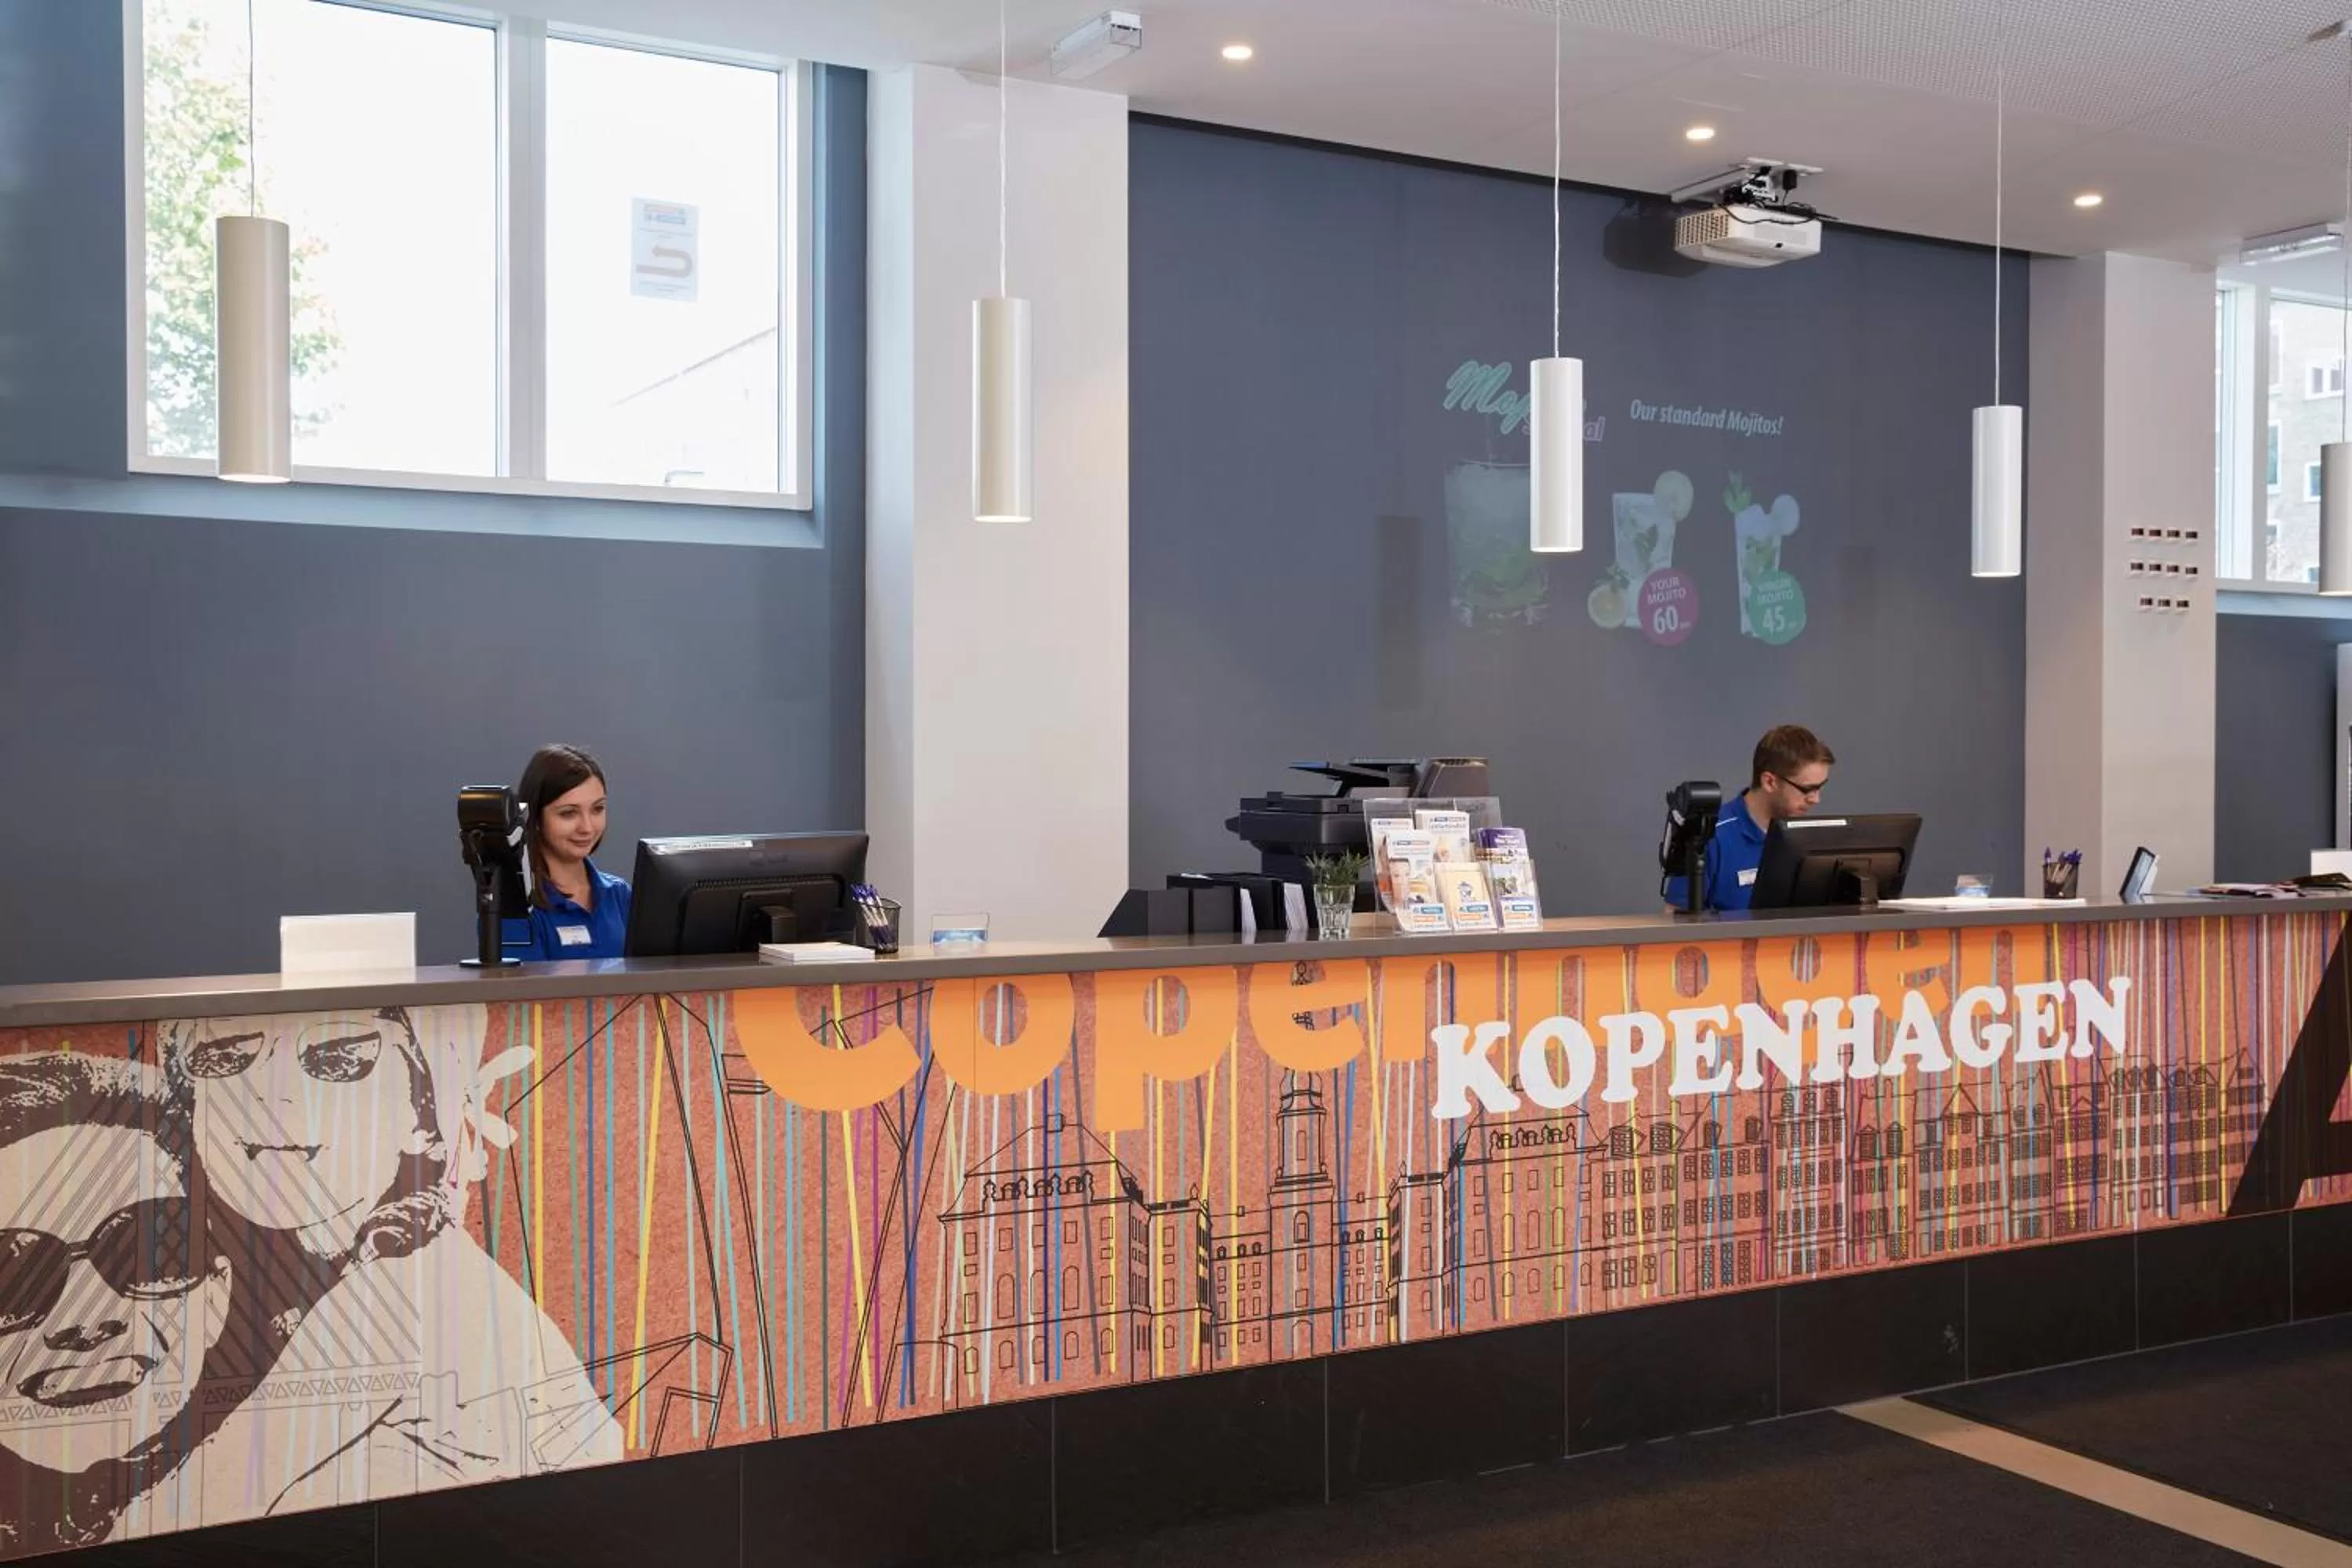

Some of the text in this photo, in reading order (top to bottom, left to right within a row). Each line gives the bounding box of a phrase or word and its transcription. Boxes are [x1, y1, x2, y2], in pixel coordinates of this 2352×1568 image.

[1630, 398, 1784, 437] Our standard Mojitos!
[1647, 587, 1687, 604] MOJITO
[1653, 605, 1679, 634] 60
[1762, 605, 1785, 634] 45
[1430, 975, 2131, 1121] KOPENHAGEN
